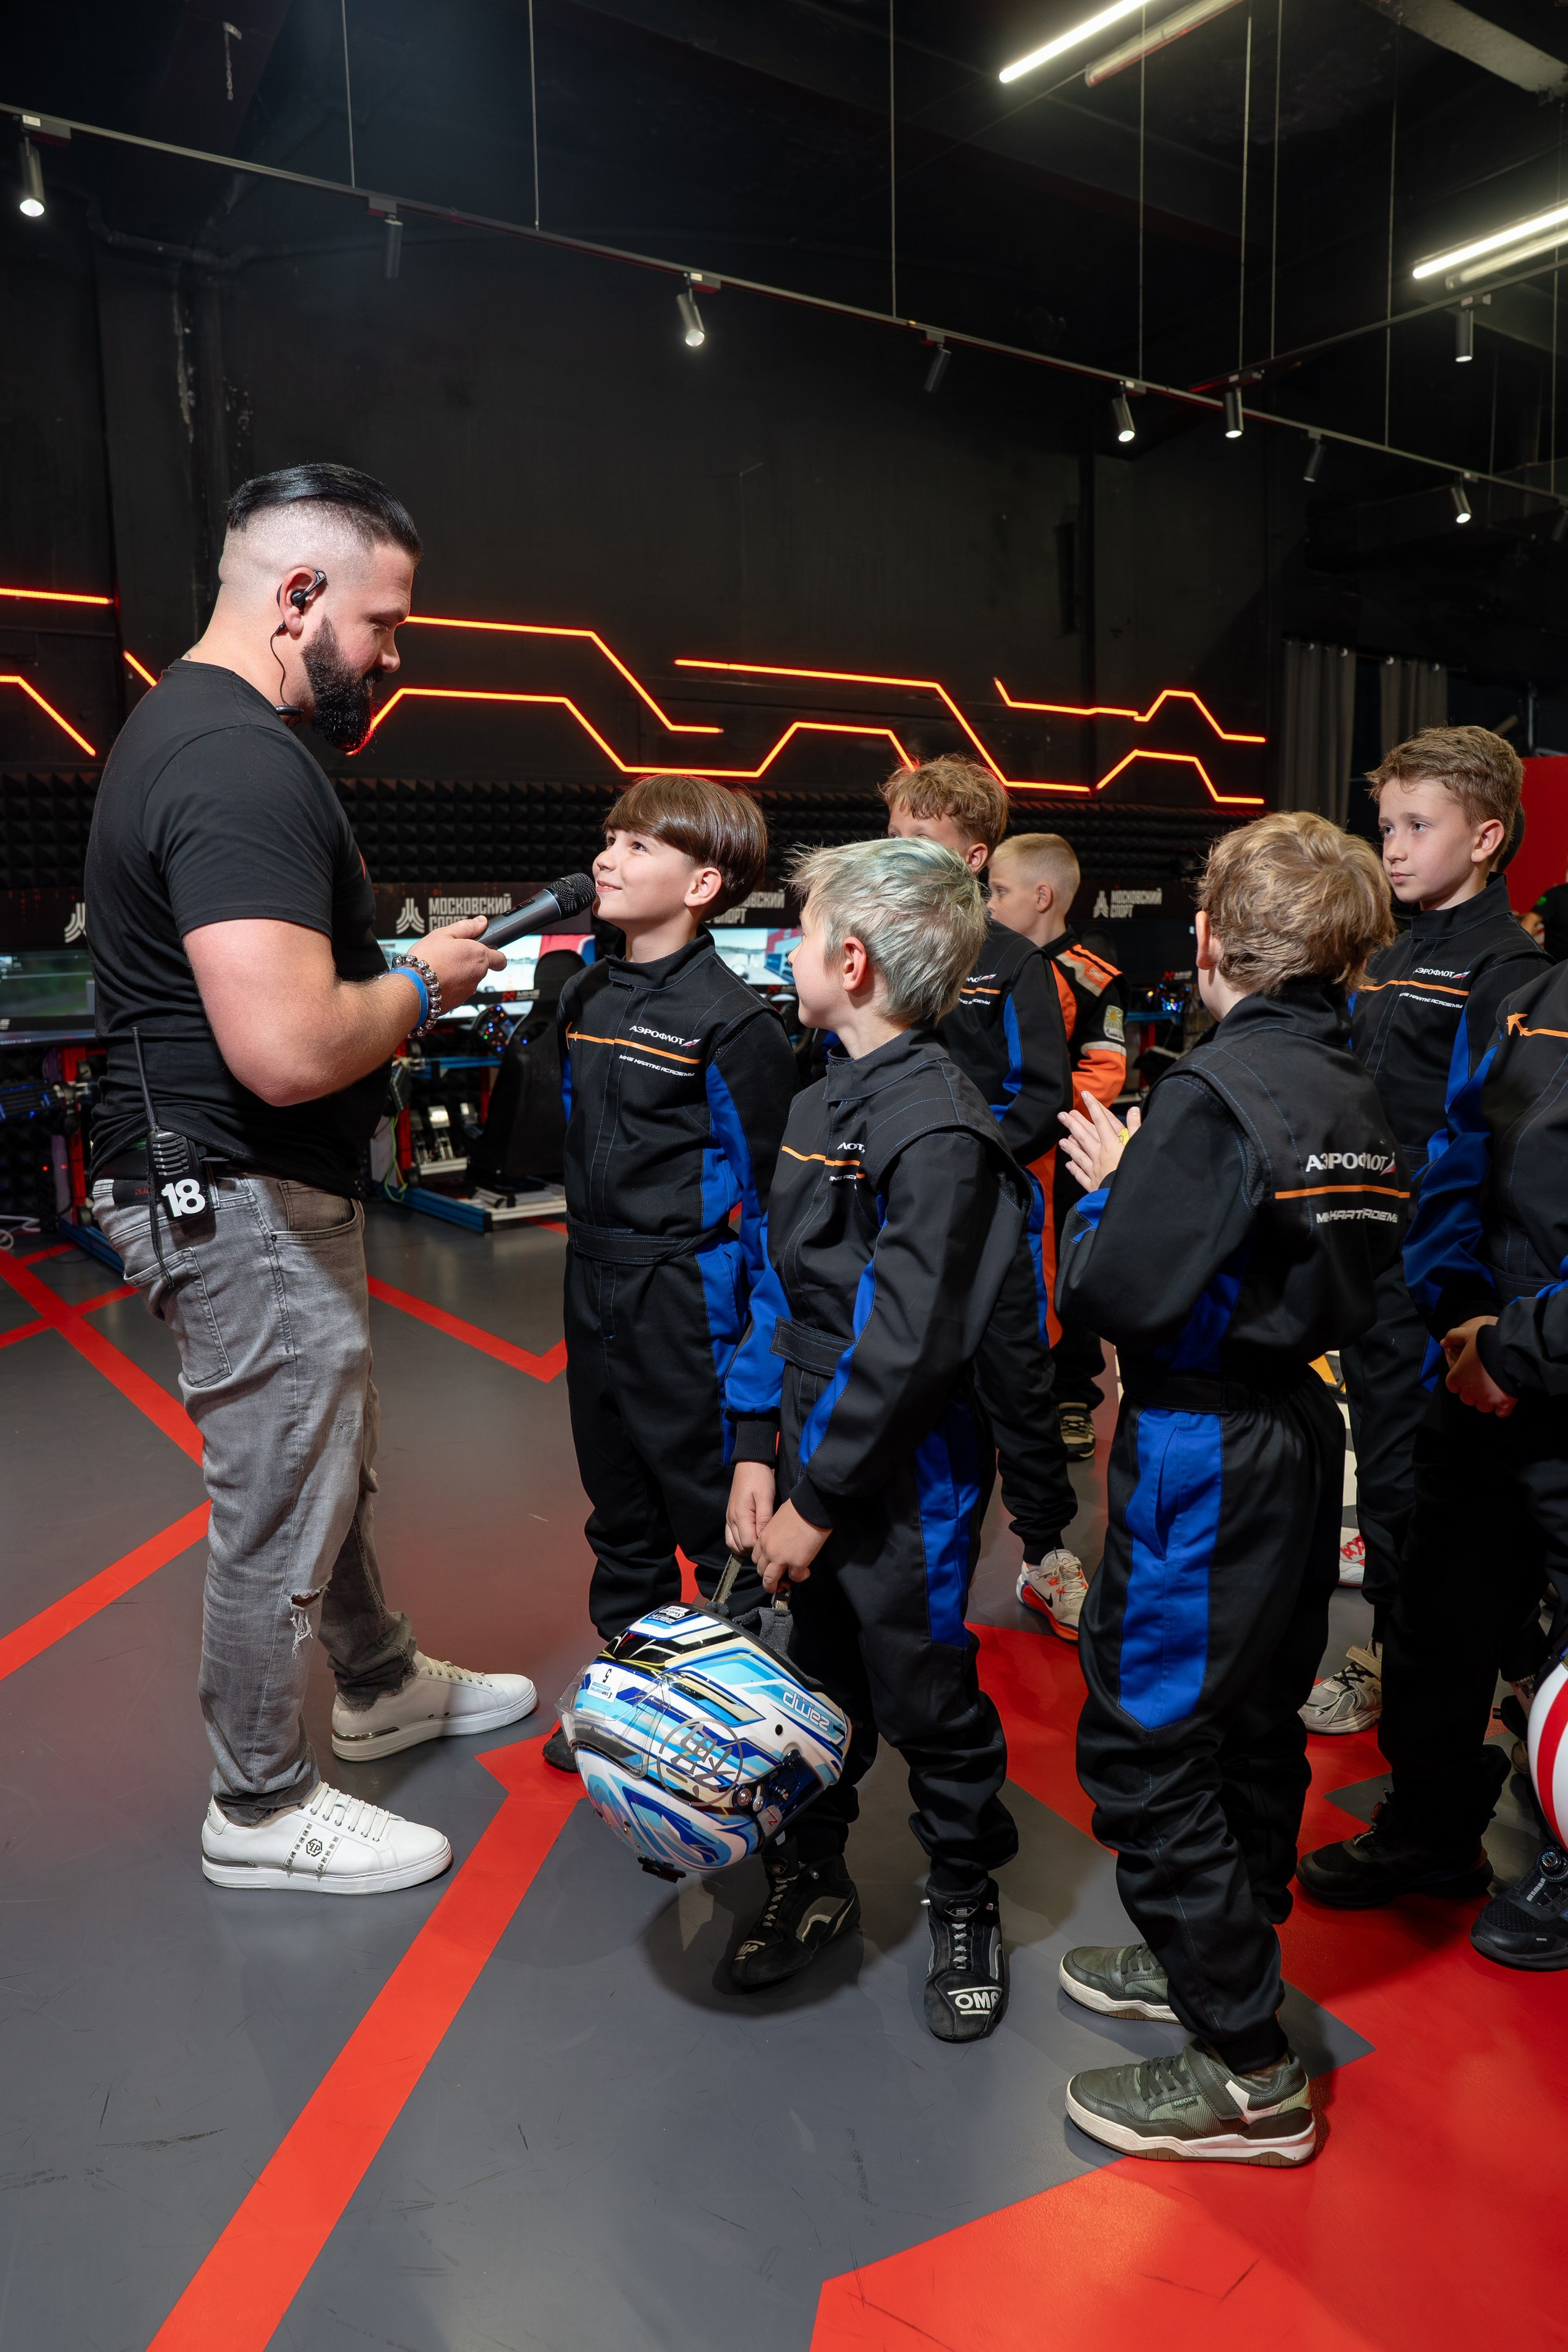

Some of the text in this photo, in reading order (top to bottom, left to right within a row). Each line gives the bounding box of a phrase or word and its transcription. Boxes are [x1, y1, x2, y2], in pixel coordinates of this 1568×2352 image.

[429, 893, 512, 915] МОСКОВСКИЙ
[742, 889, 785, 909] ОВСКИЙ
[1110, 888, 1163, 905] МОСКОВСКИЙ
[1110, 904, 1134, 918] СПОРТ
[629, 1025, 685, 1045] АЭРОФЛОТ
[619, 1054, 695, 1077] MKS KARTING ACADEMY
[162, 1178, 206, 1218] 18
[602, 1668, 612, 1683] 5
[782, 1691, 830, 1732] zamp
[955, 1991, 999, 2009] OMP
[1174, 2097, 1194, 2106] GEOX
